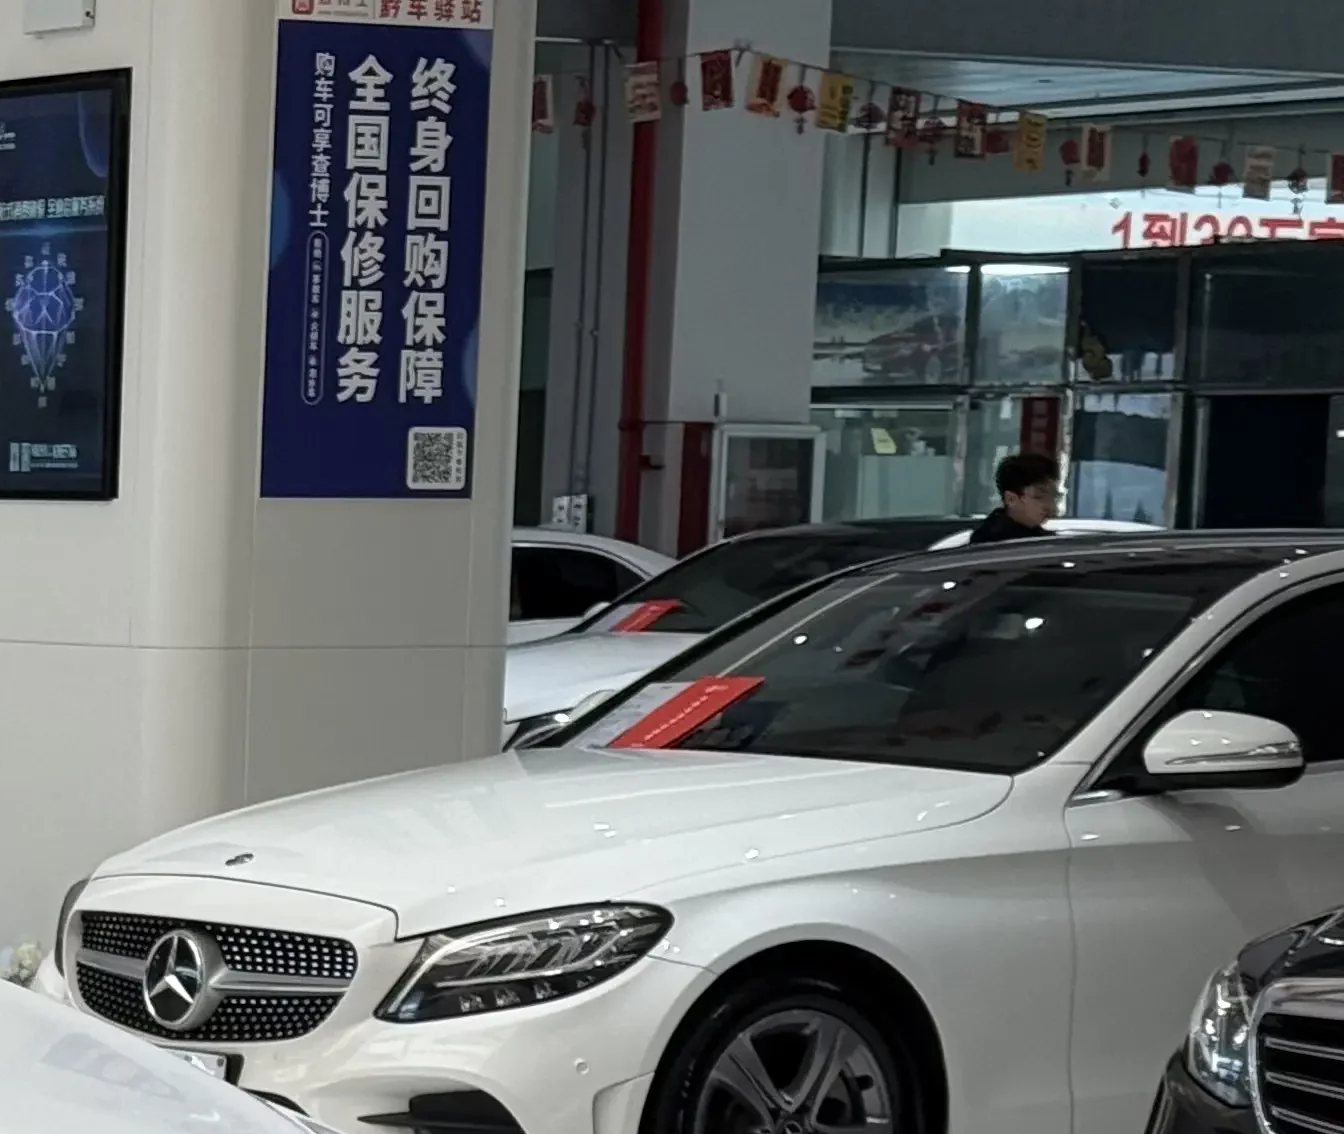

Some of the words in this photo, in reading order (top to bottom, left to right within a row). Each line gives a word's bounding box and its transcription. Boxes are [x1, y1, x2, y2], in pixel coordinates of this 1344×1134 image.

[308, 52, 336, 228] 购车可享查博士
[337, 54, 394, 404] 全国保修服务
[398, 57, 457, 405] 终身回购保障
